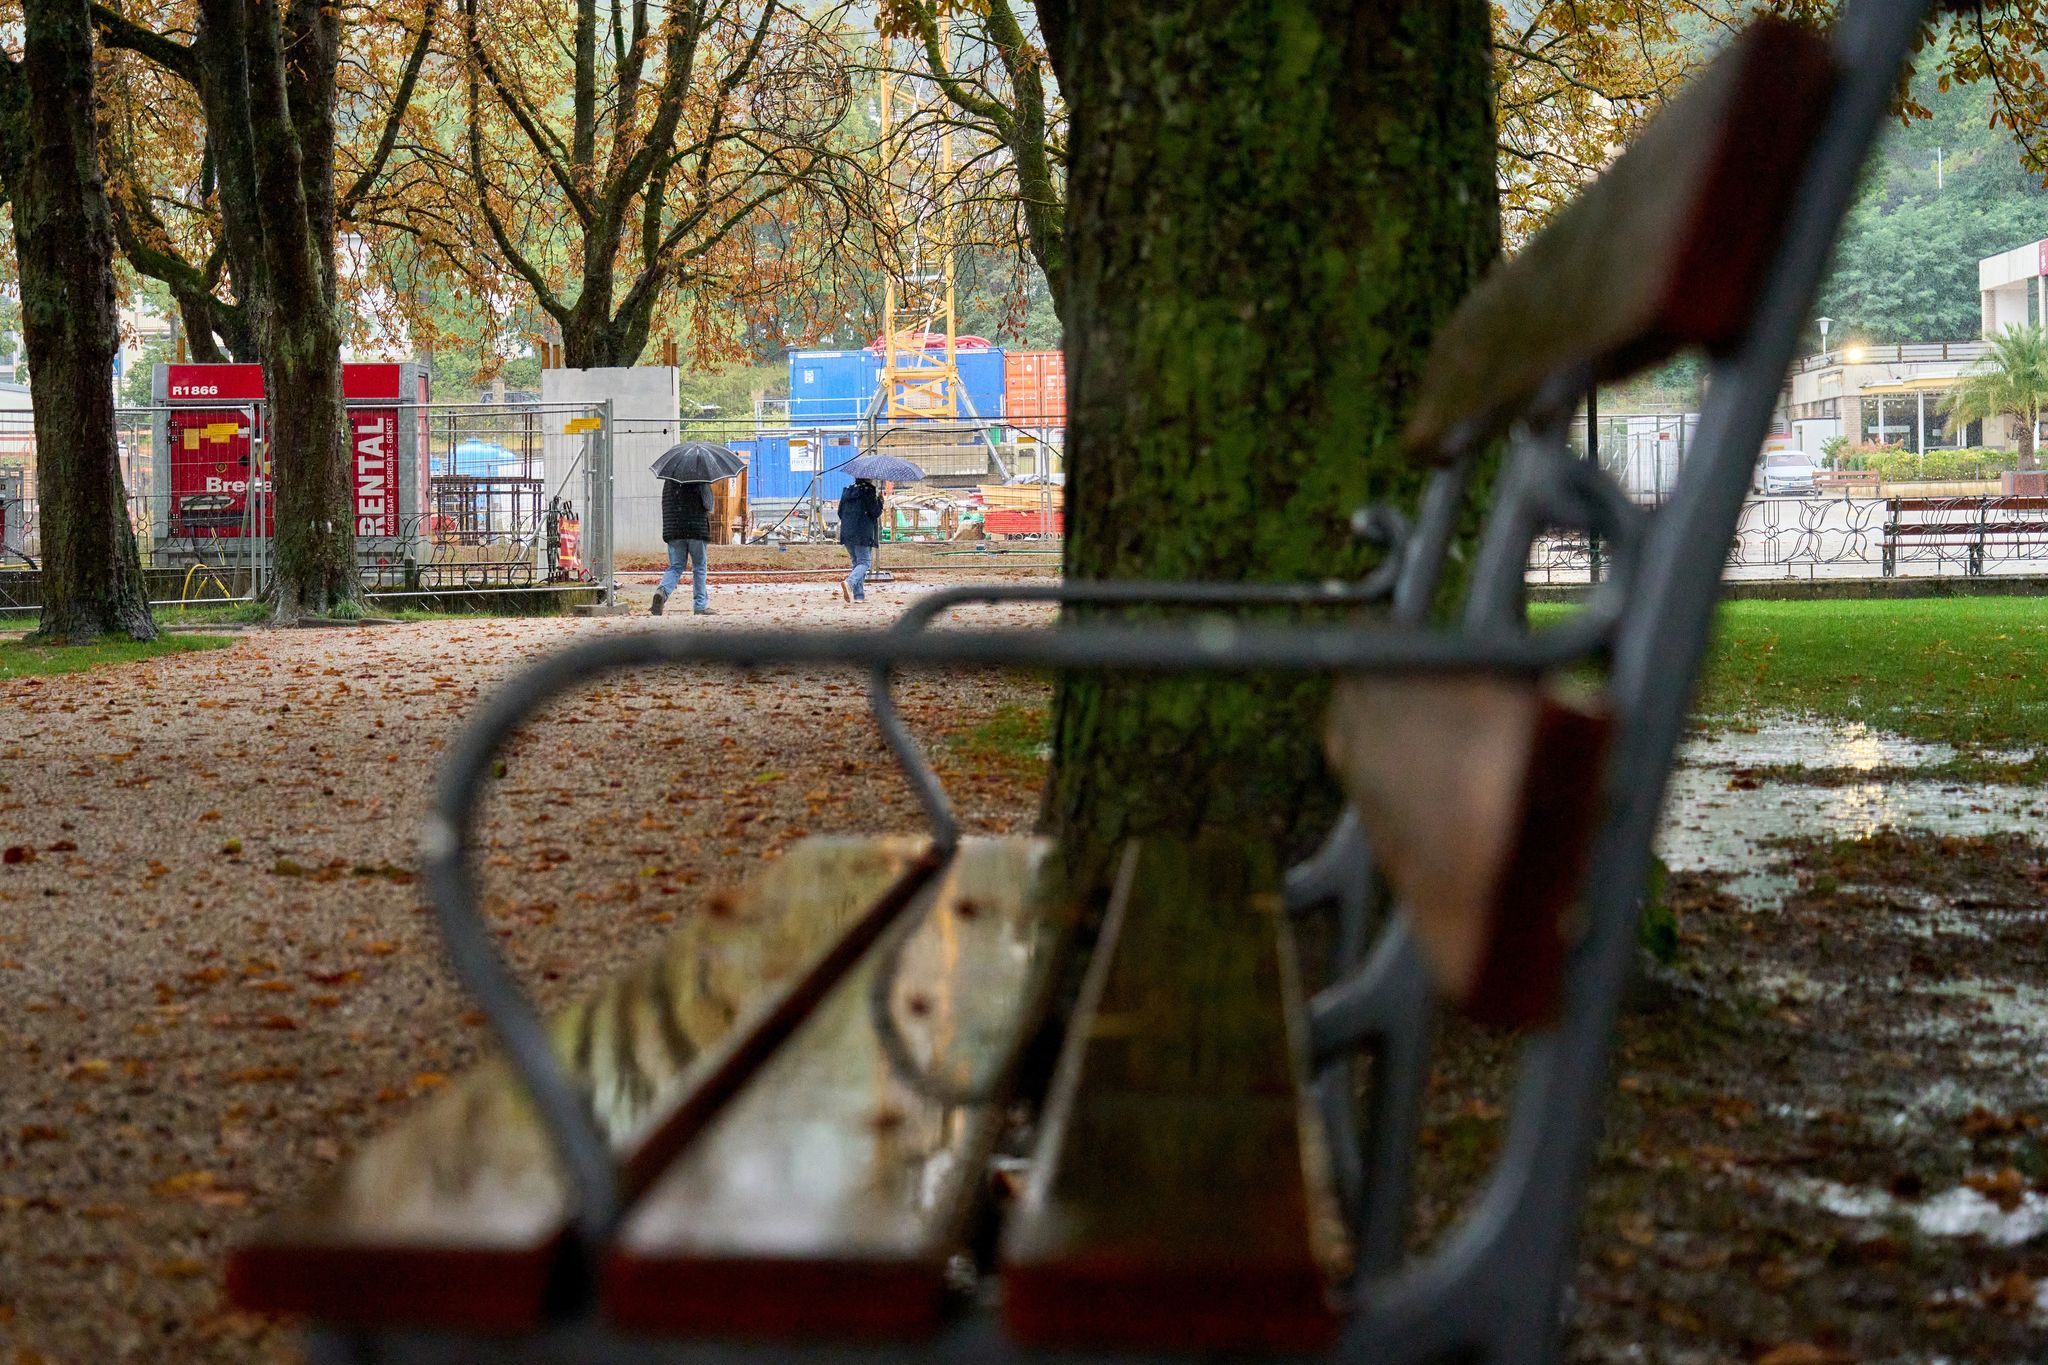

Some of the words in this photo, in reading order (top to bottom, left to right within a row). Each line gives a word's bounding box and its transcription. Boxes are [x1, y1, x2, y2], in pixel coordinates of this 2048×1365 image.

[172, 386, 218, 395] R1866
[358, 418, 385, 536] RENTAL
[386, 450, 394, 488] AGGREGATE
